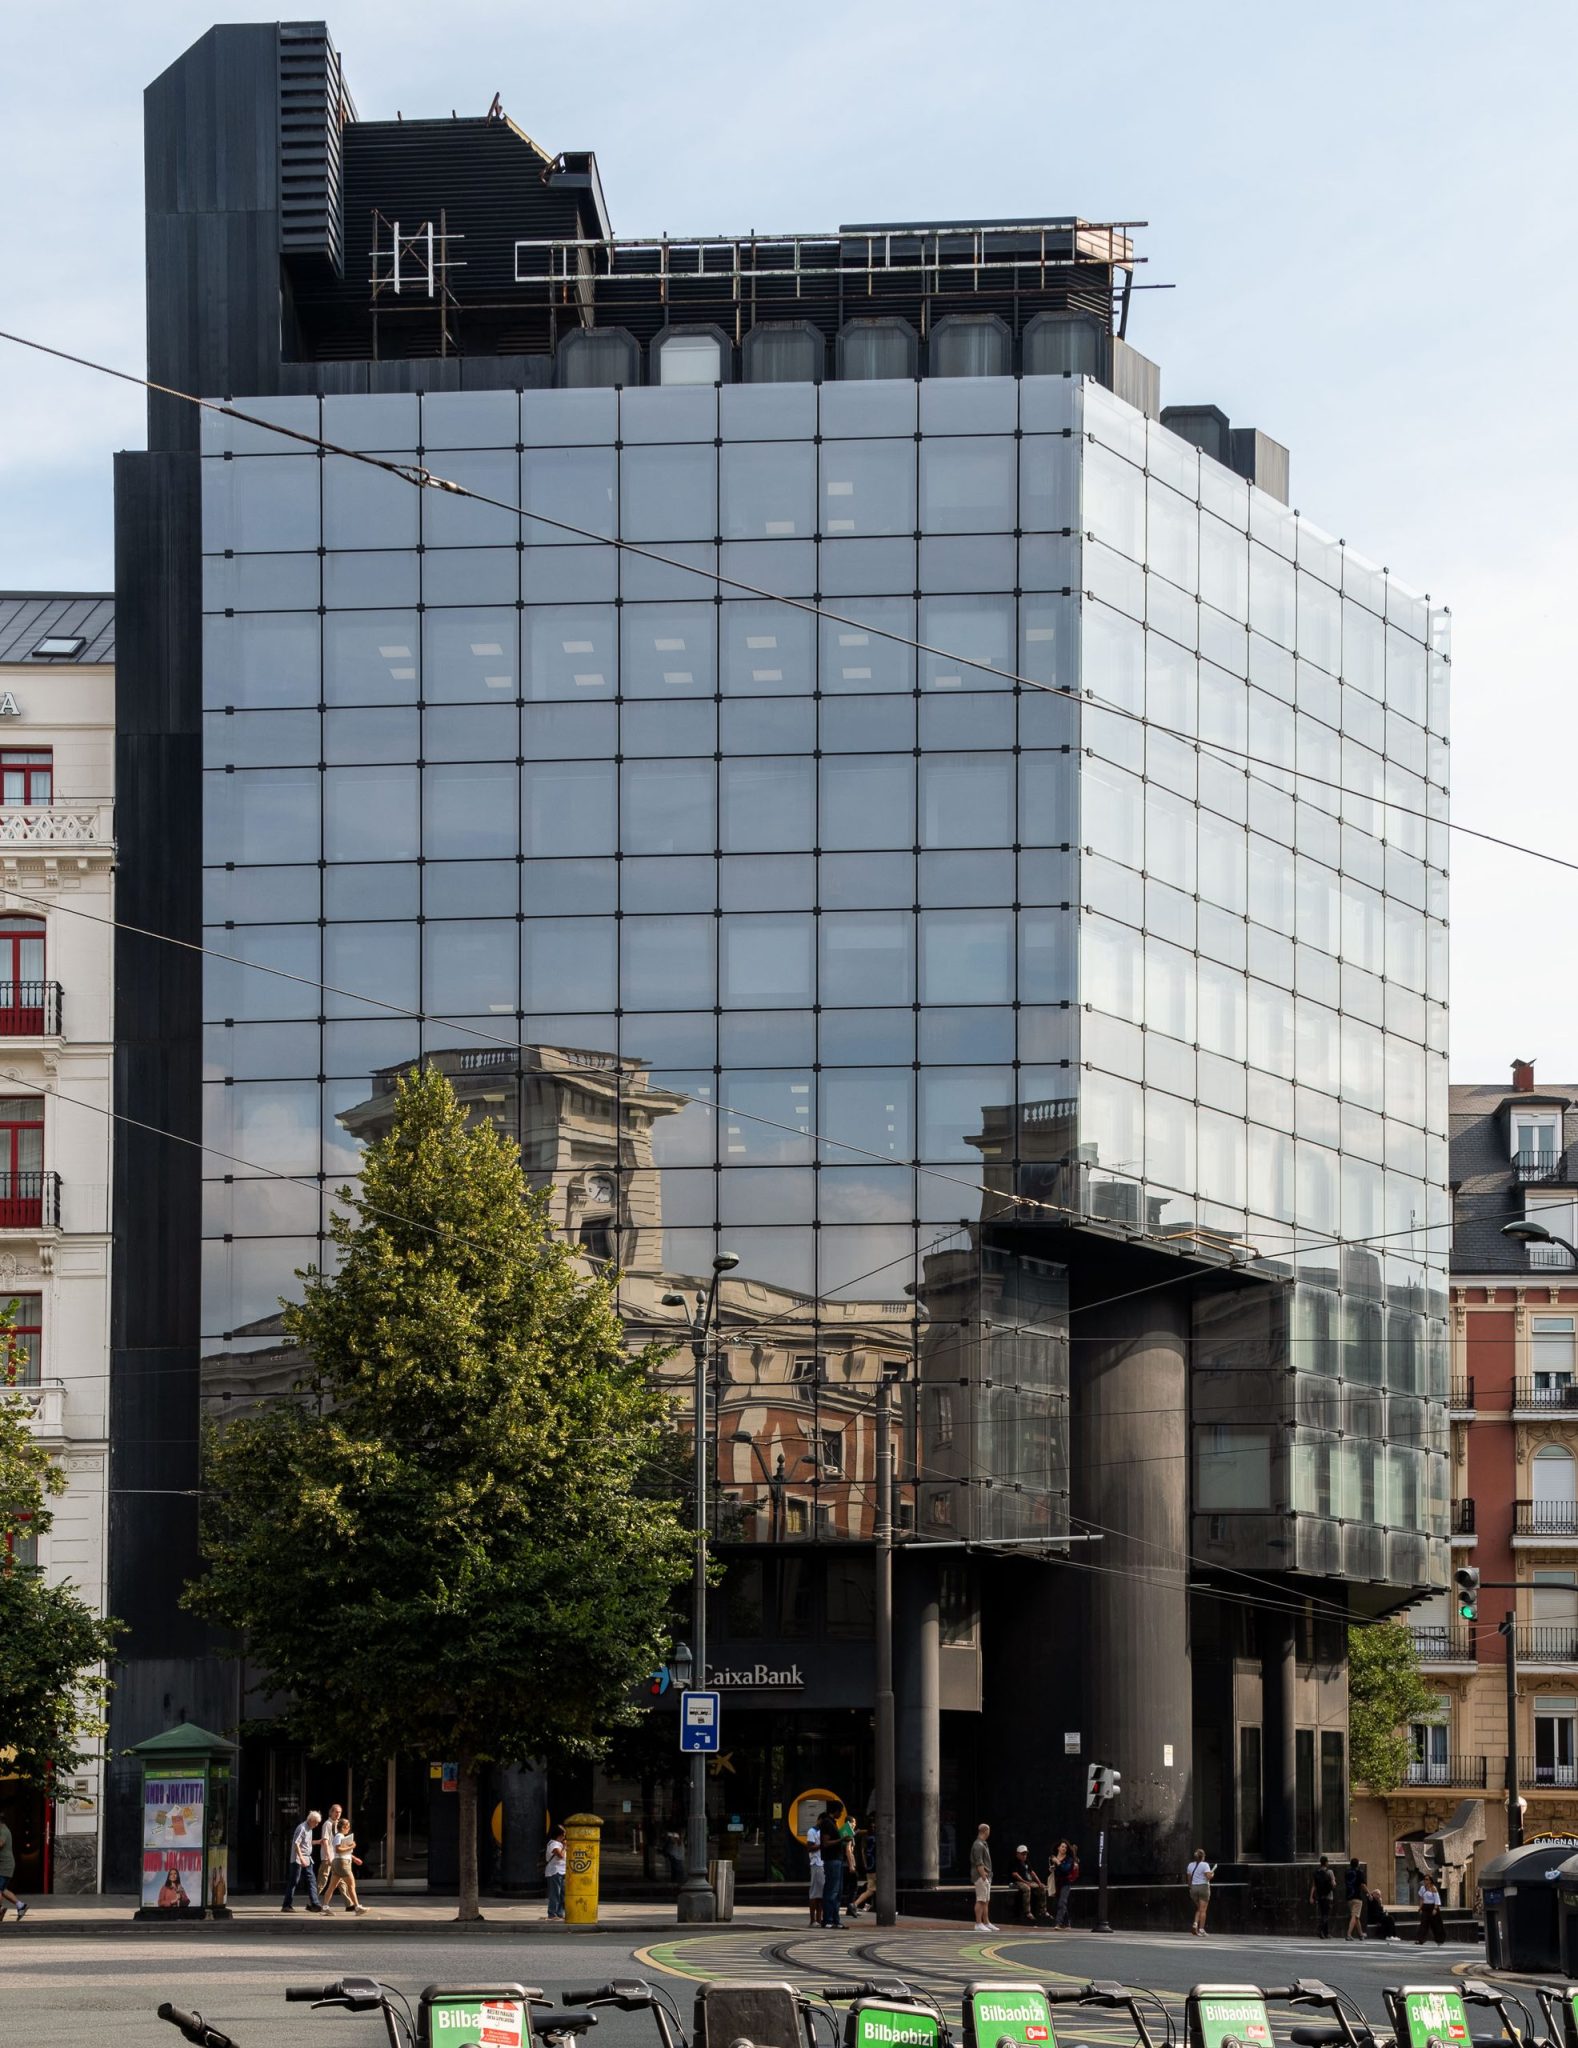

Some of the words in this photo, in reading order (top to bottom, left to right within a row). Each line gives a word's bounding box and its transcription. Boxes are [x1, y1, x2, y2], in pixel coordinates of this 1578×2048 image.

[438, 2009, 482, 2029] Bilba
[980, 2004, 1045, 2021] Bilbaobizi
[1205, 2005, 1262, 2021] Bilbaobizi
[1411, 2005, 1463, 2022] Biizi
[864, 2022, 934, 2046] Bilbaobizi
